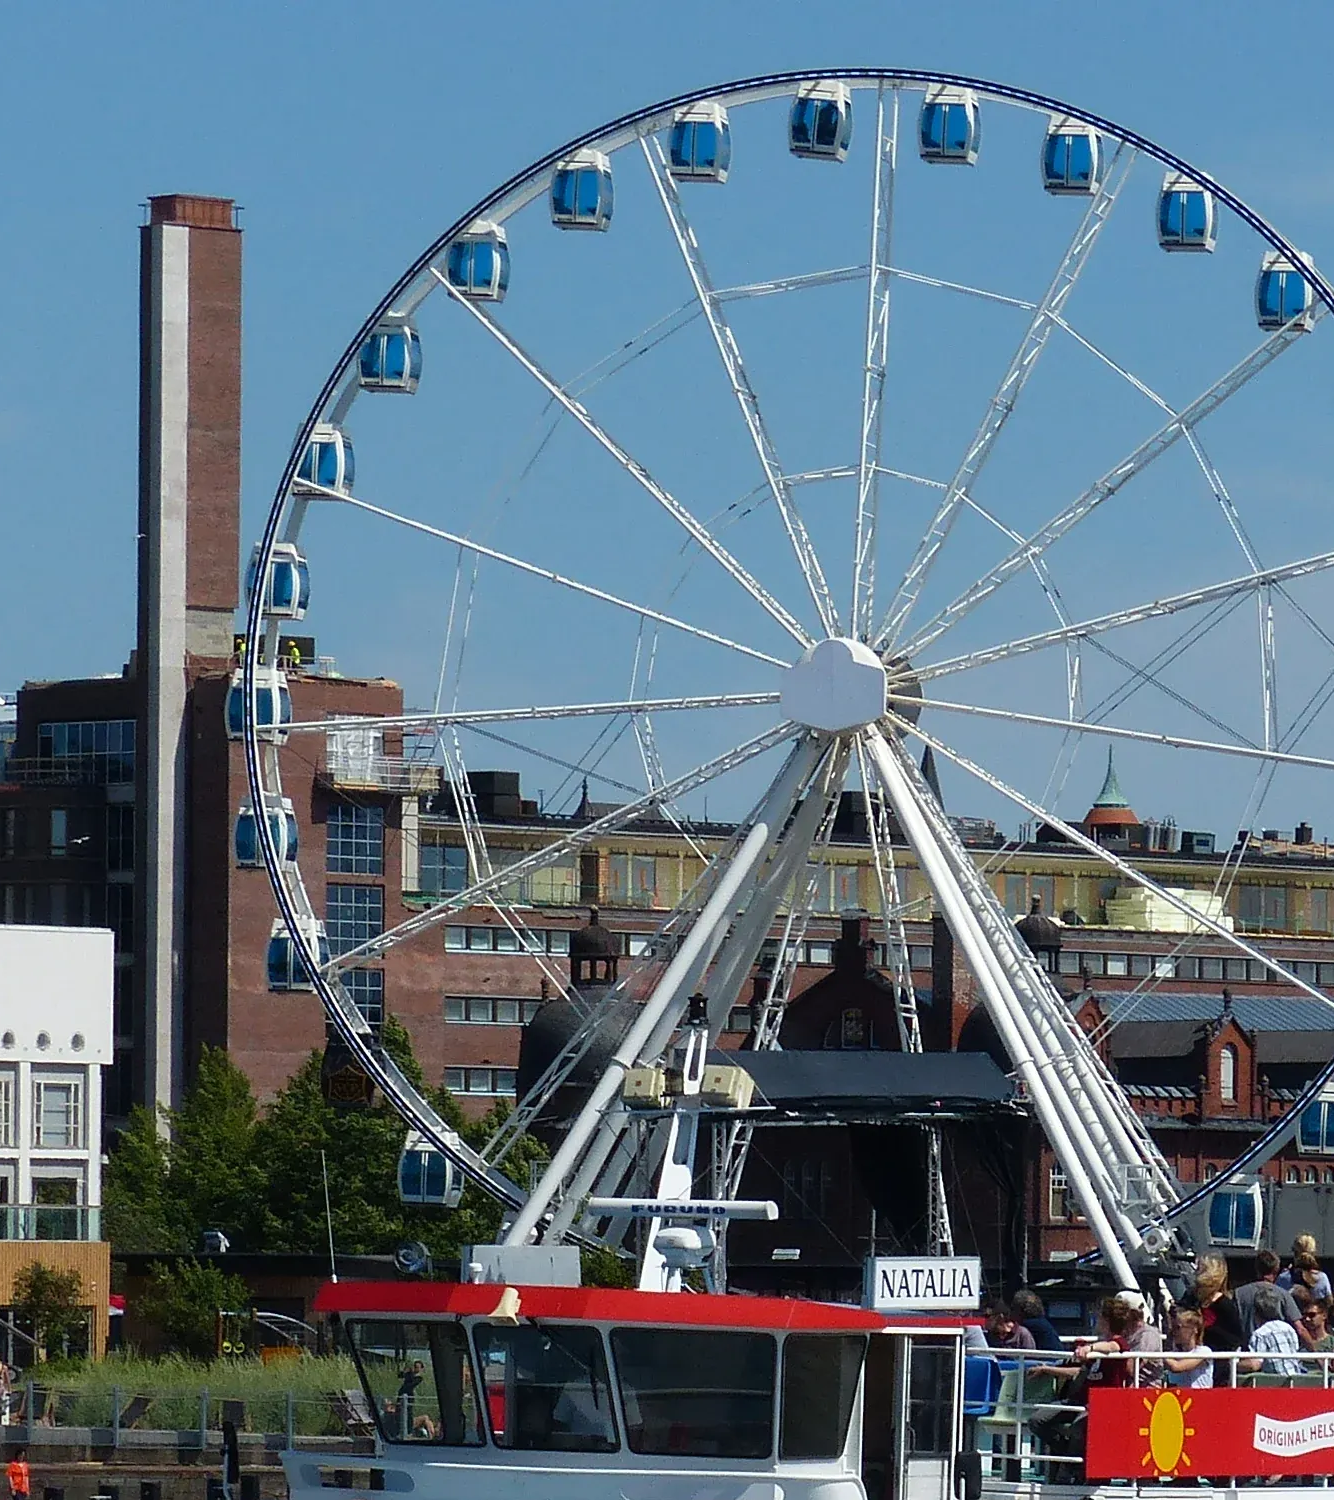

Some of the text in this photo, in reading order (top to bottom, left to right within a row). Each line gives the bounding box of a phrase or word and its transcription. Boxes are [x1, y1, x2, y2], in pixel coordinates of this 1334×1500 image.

[631, 1203, 726, 1215] FURUNO
[880, 1268, 974, 1299] NATALIA
[1258, 1426, 1308, 1447] ORIGINAL
